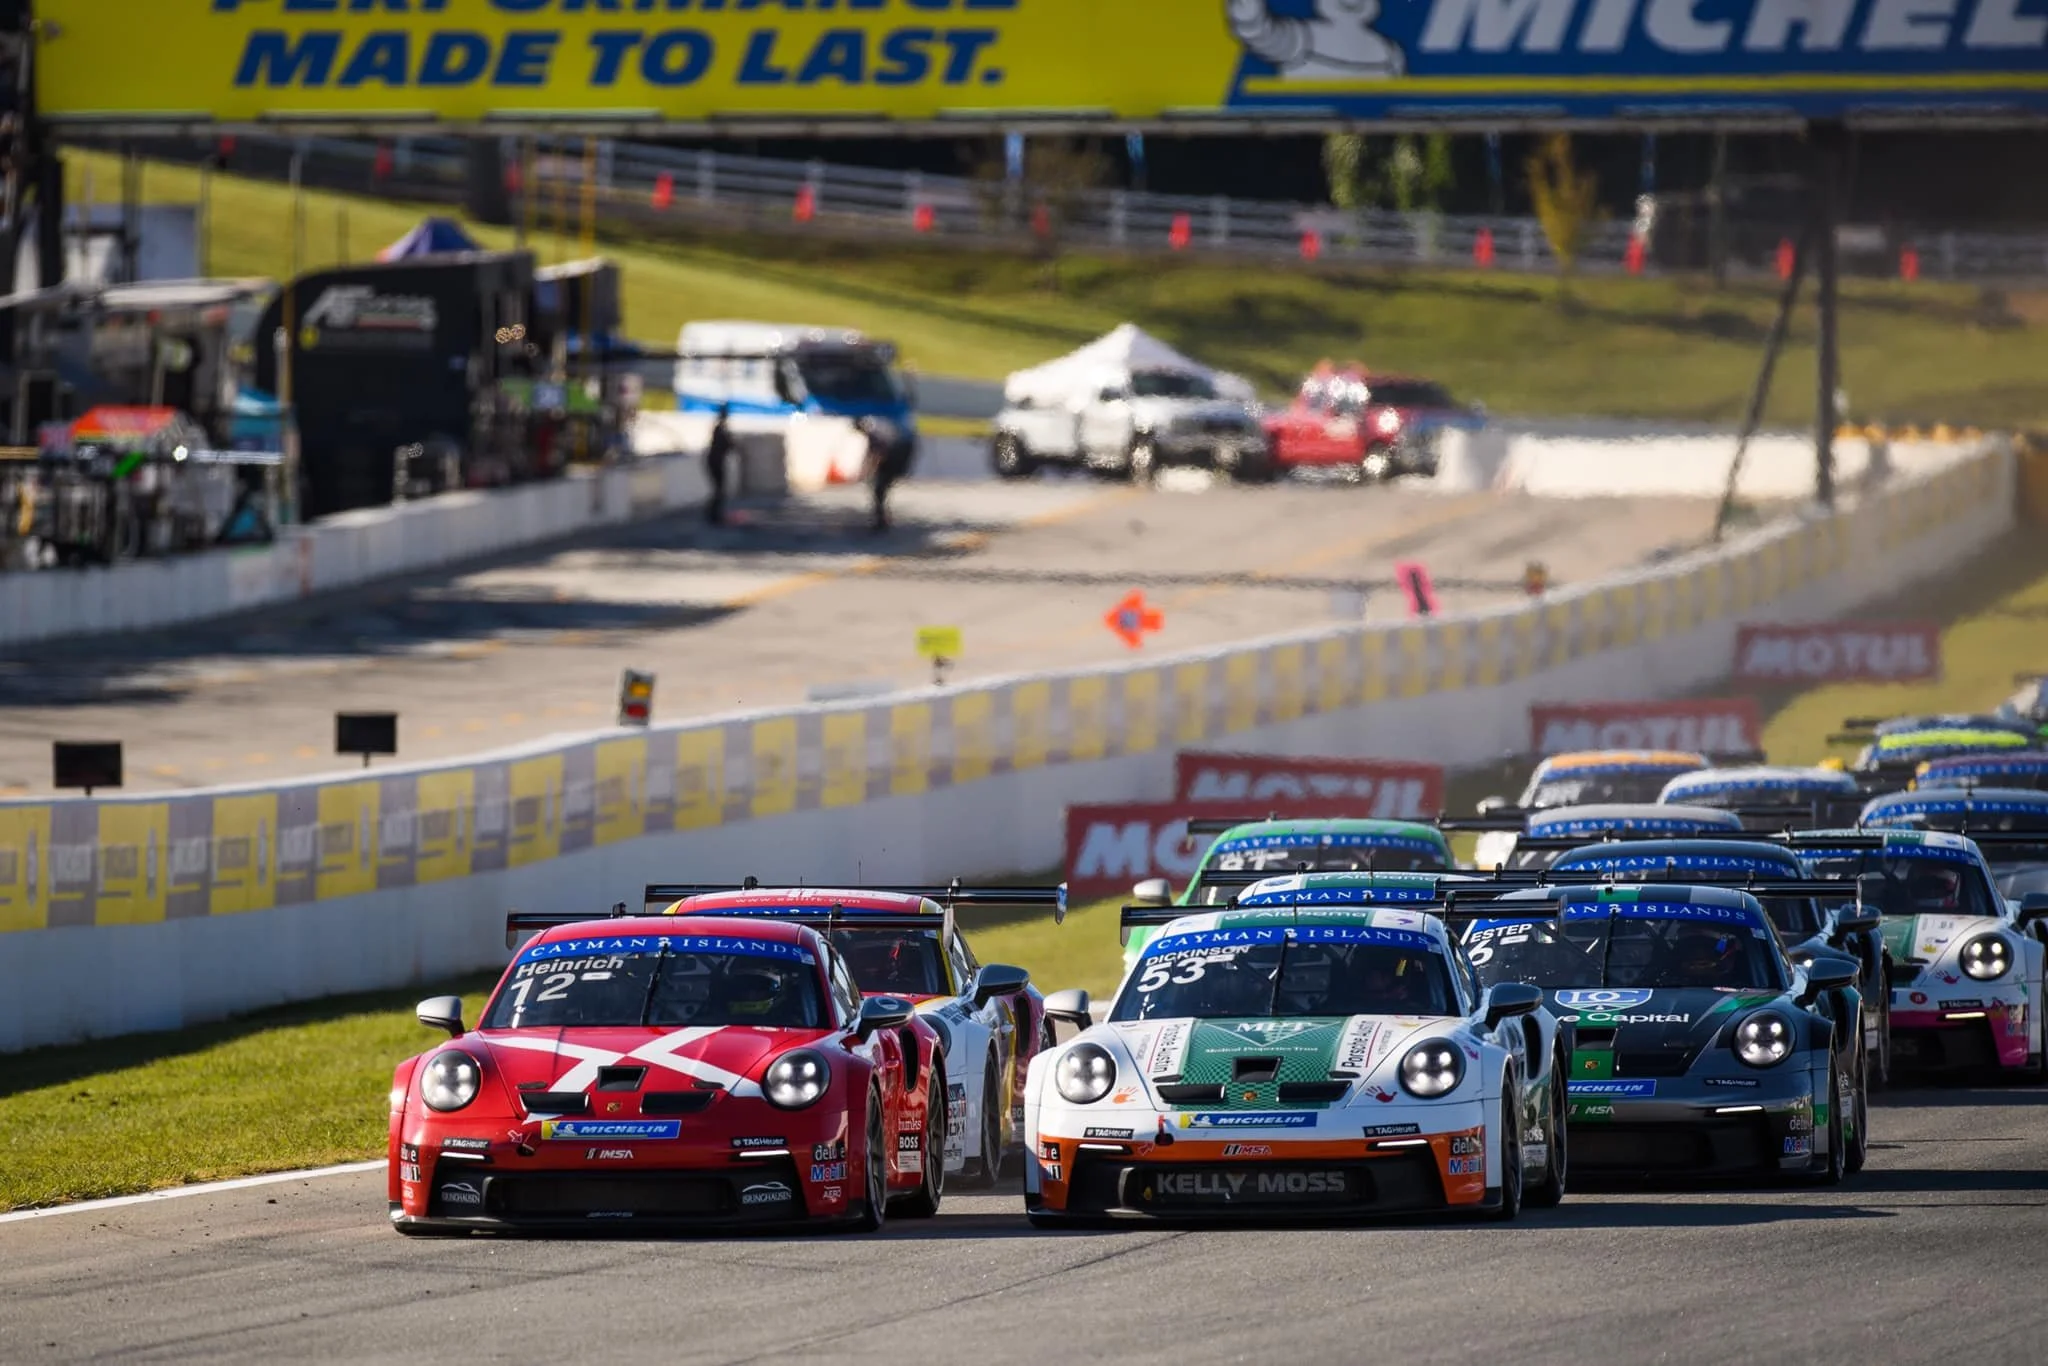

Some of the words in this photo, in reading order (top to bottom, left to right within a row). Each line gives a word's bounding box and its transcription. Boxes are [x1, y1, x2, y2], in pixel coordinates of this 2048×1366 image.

[233, 29, 562, 88] MADE
[588, 28, 717, 87] TO
[734, 27, 1006, 87] LAST.
[1743, 633, 1930, 675] MOTUL
[1540, 714, 1750, 752] MOTUL
[1223, 836, 1315, 850] CAYMAN
[1632, 904, 1746, 920] ISLANDS
[1157, 931, 1273, 950] CAYMAN
[1309, 929, 1430, 946] ISLANDS
[1470, 924, 1533, 943] ESTEP
[531, 937, 648, 957] CAYMAN
[684, 938, 802, 956] ISLANDS
[1147, 945, 1252, 967] DICKINSON
[1469, 941, 1494, 966] 6
[516, 956, 625, 979] Heinrich
[1137, 956, 1206, 993] 53
[510, 971, 576, 1006] 12
[1587, 1012, 1690, 1025] Capital
[1341, 1038, 1368, 1068] Porsche
[580, 1124, 669, 1134] MICHELIN
[1218, 1116, 1306, 1125] MICHELIN
[900, 1136, 919, 1149] BOSS
[599, 1149, 634, 1160] IMSA
[1157, 1173, 1247, 1194] KELLY
[1258, 1171, 1345, 1193] MOSS
